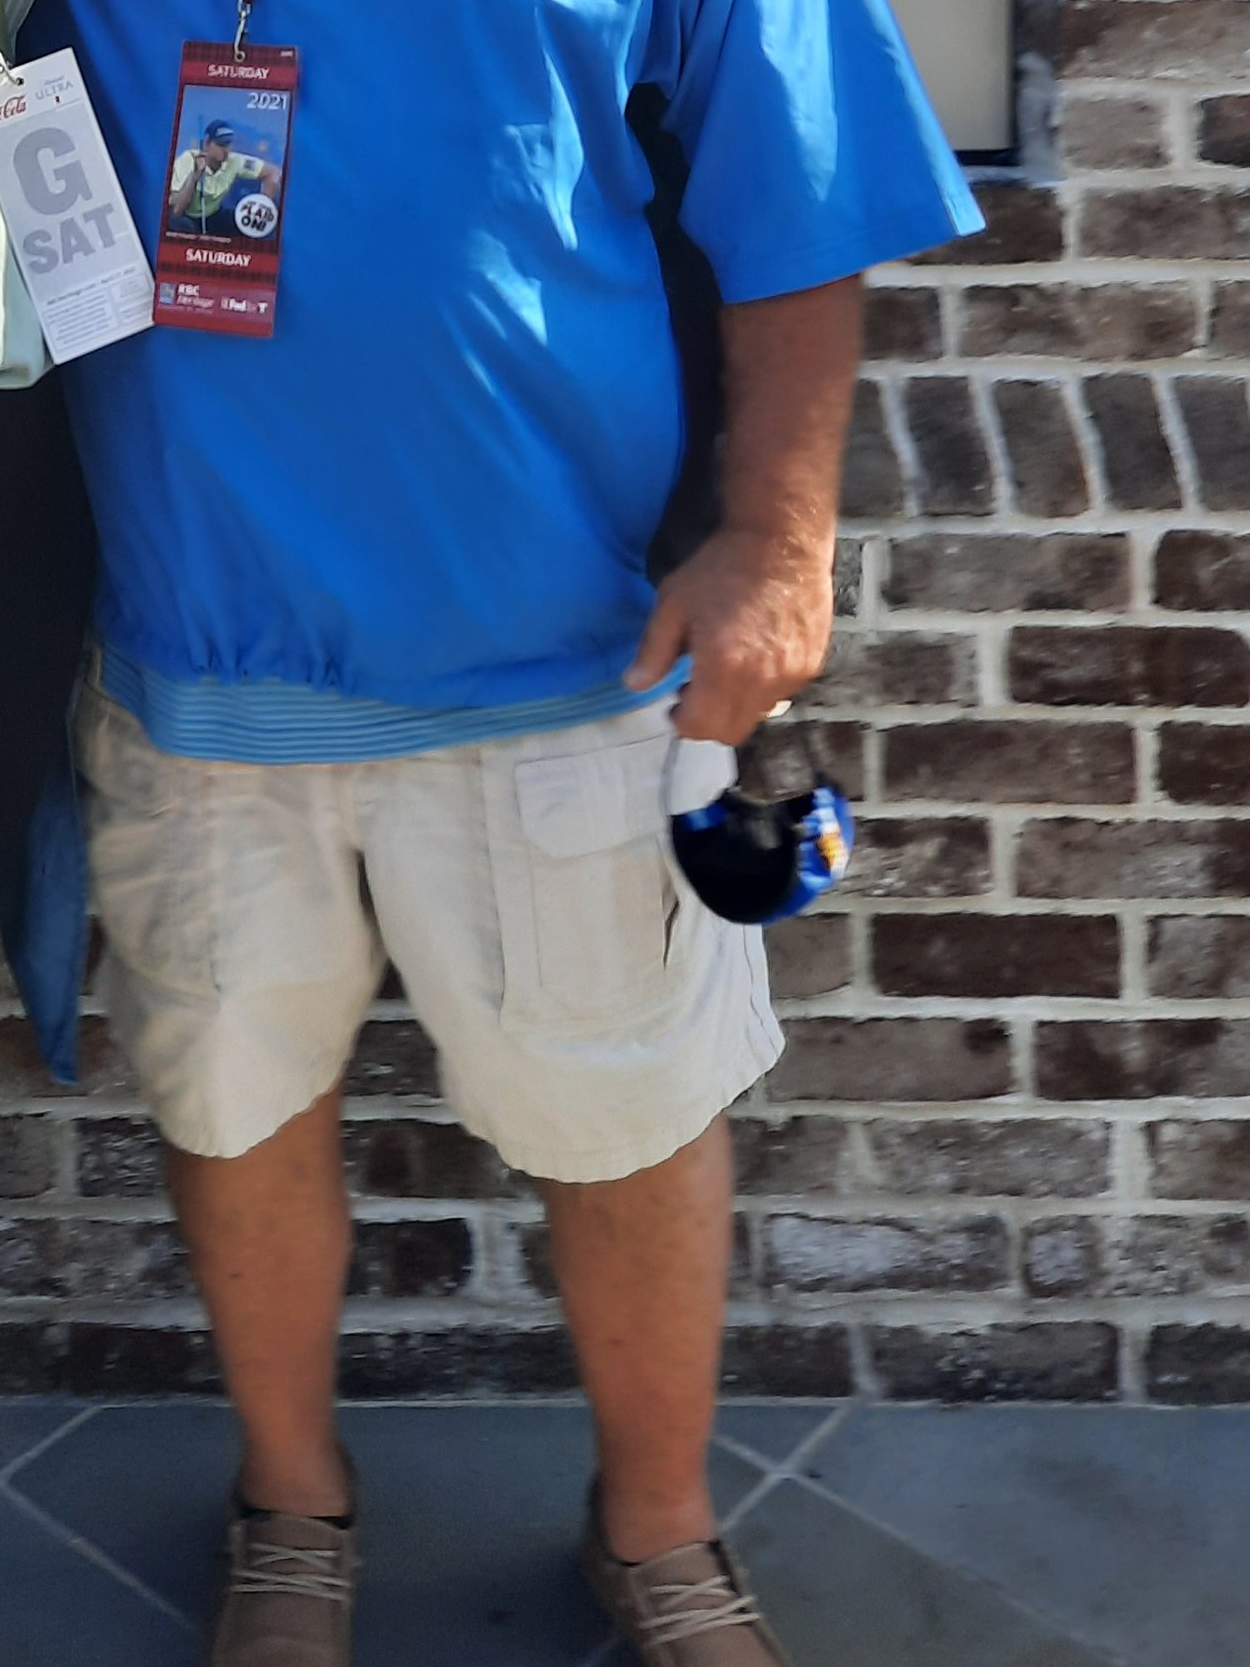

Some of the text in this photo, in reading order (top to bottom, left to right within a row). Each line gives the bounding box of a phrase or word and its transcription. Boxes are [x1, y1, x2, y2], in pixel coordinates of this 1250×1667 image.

[207, 65, 270, 80] SATURDAY
[246, 92, 288, 110] 2021
[13, 127, 94, 216] G
[23, 203, 116, 275] SAT
[185, 248, 252, 267] SATURDAY
